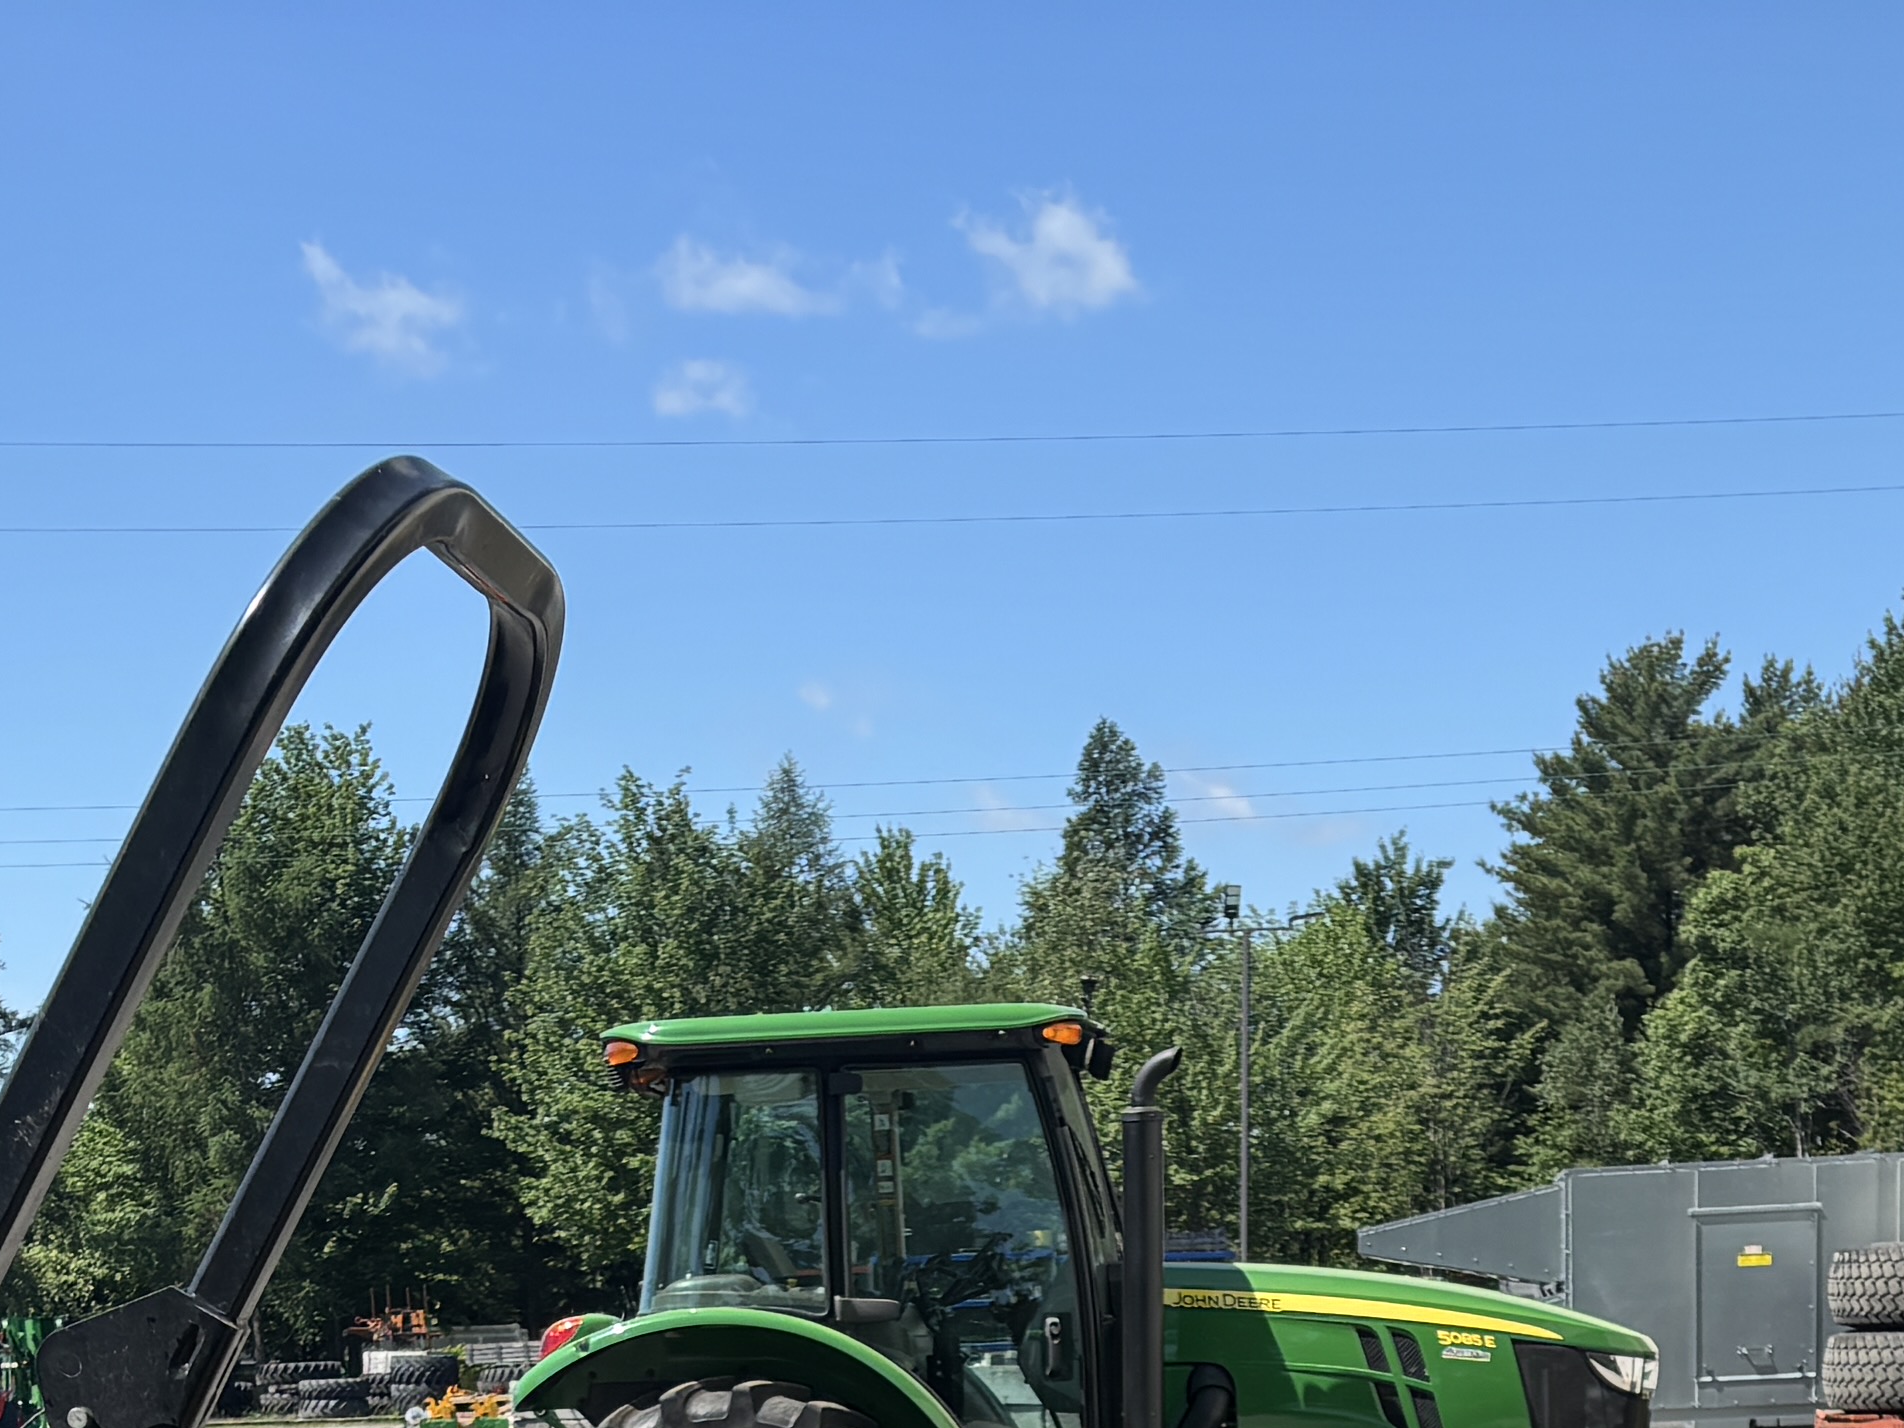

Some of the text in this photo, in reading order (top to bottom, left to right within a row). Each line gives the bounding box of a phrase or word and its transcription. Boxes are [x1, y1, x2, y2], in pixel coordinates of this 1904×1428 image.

[1173, 1292, 1281, 1310] JOHN DEERE
[1436, 1329, 1497, 1349] 5085 E
